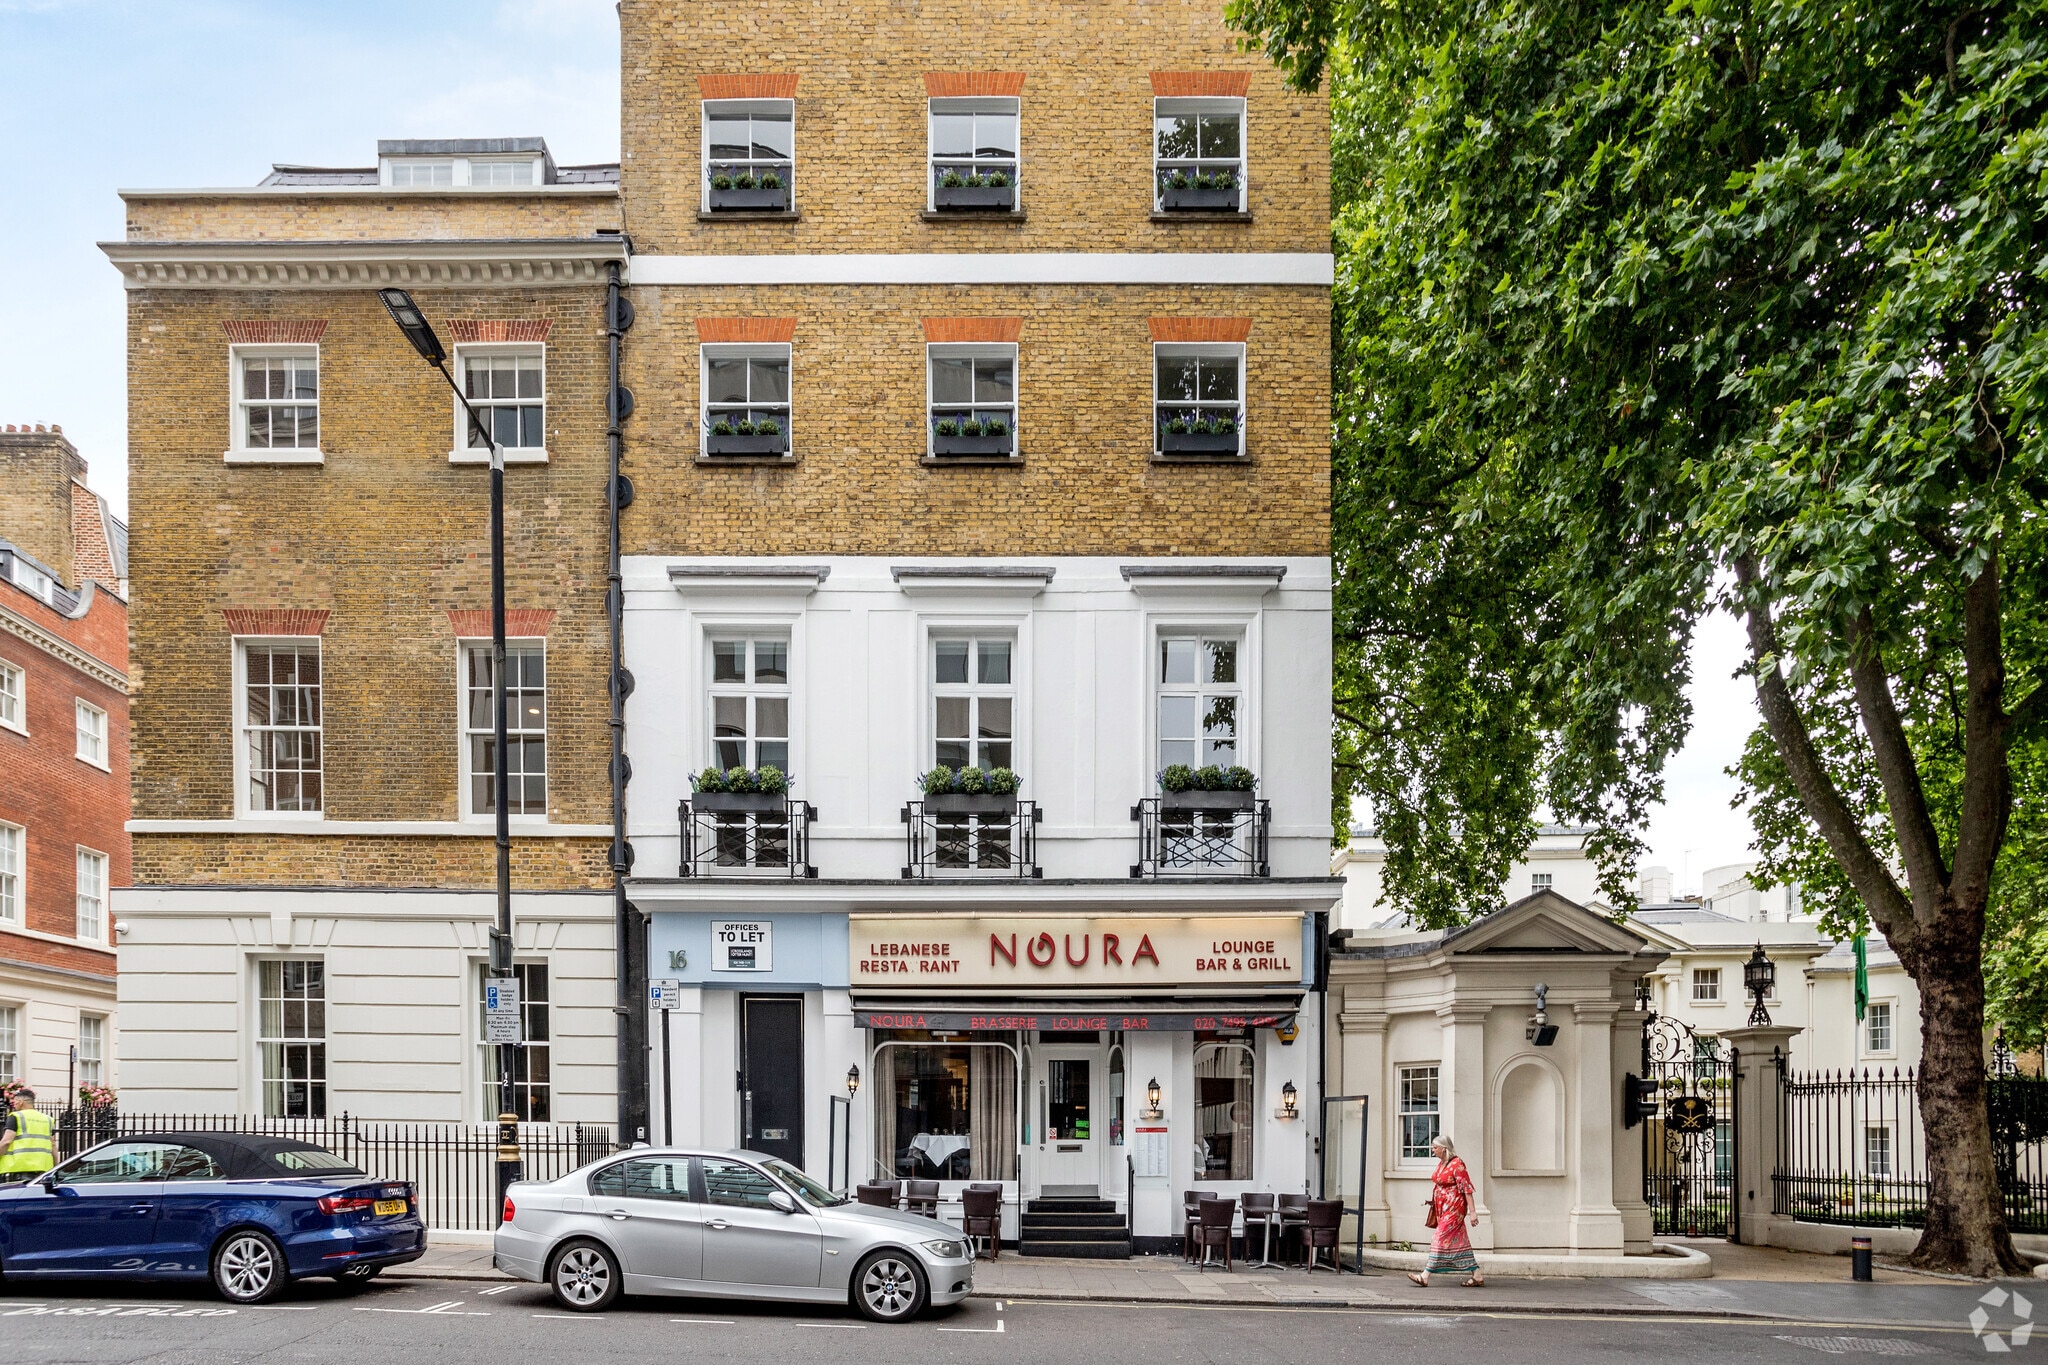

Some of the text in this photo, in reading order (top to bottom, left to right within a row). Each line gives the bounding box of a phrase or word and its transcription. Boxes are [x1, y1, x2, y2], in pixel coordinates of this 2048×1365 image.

[718, 931, 765, 942] TO LET
[870, 943, 950, 957] LEBANESE
[990, 931, 1160, 968] NOURA
[1212, 941, 1275, 954] LOUNGE
[668, 949, 688, 969] 16
[1196, 957, 1292, 970] BAR & GRILL
[869, 1014, 927, 1028] NOURA
[970, 1017, 1149, 1030] BRASSERIE LOUNGE BAR
[1194, 1017, 1216, 1030] 020
[2, 1307, 238, 1317] DISABLED
